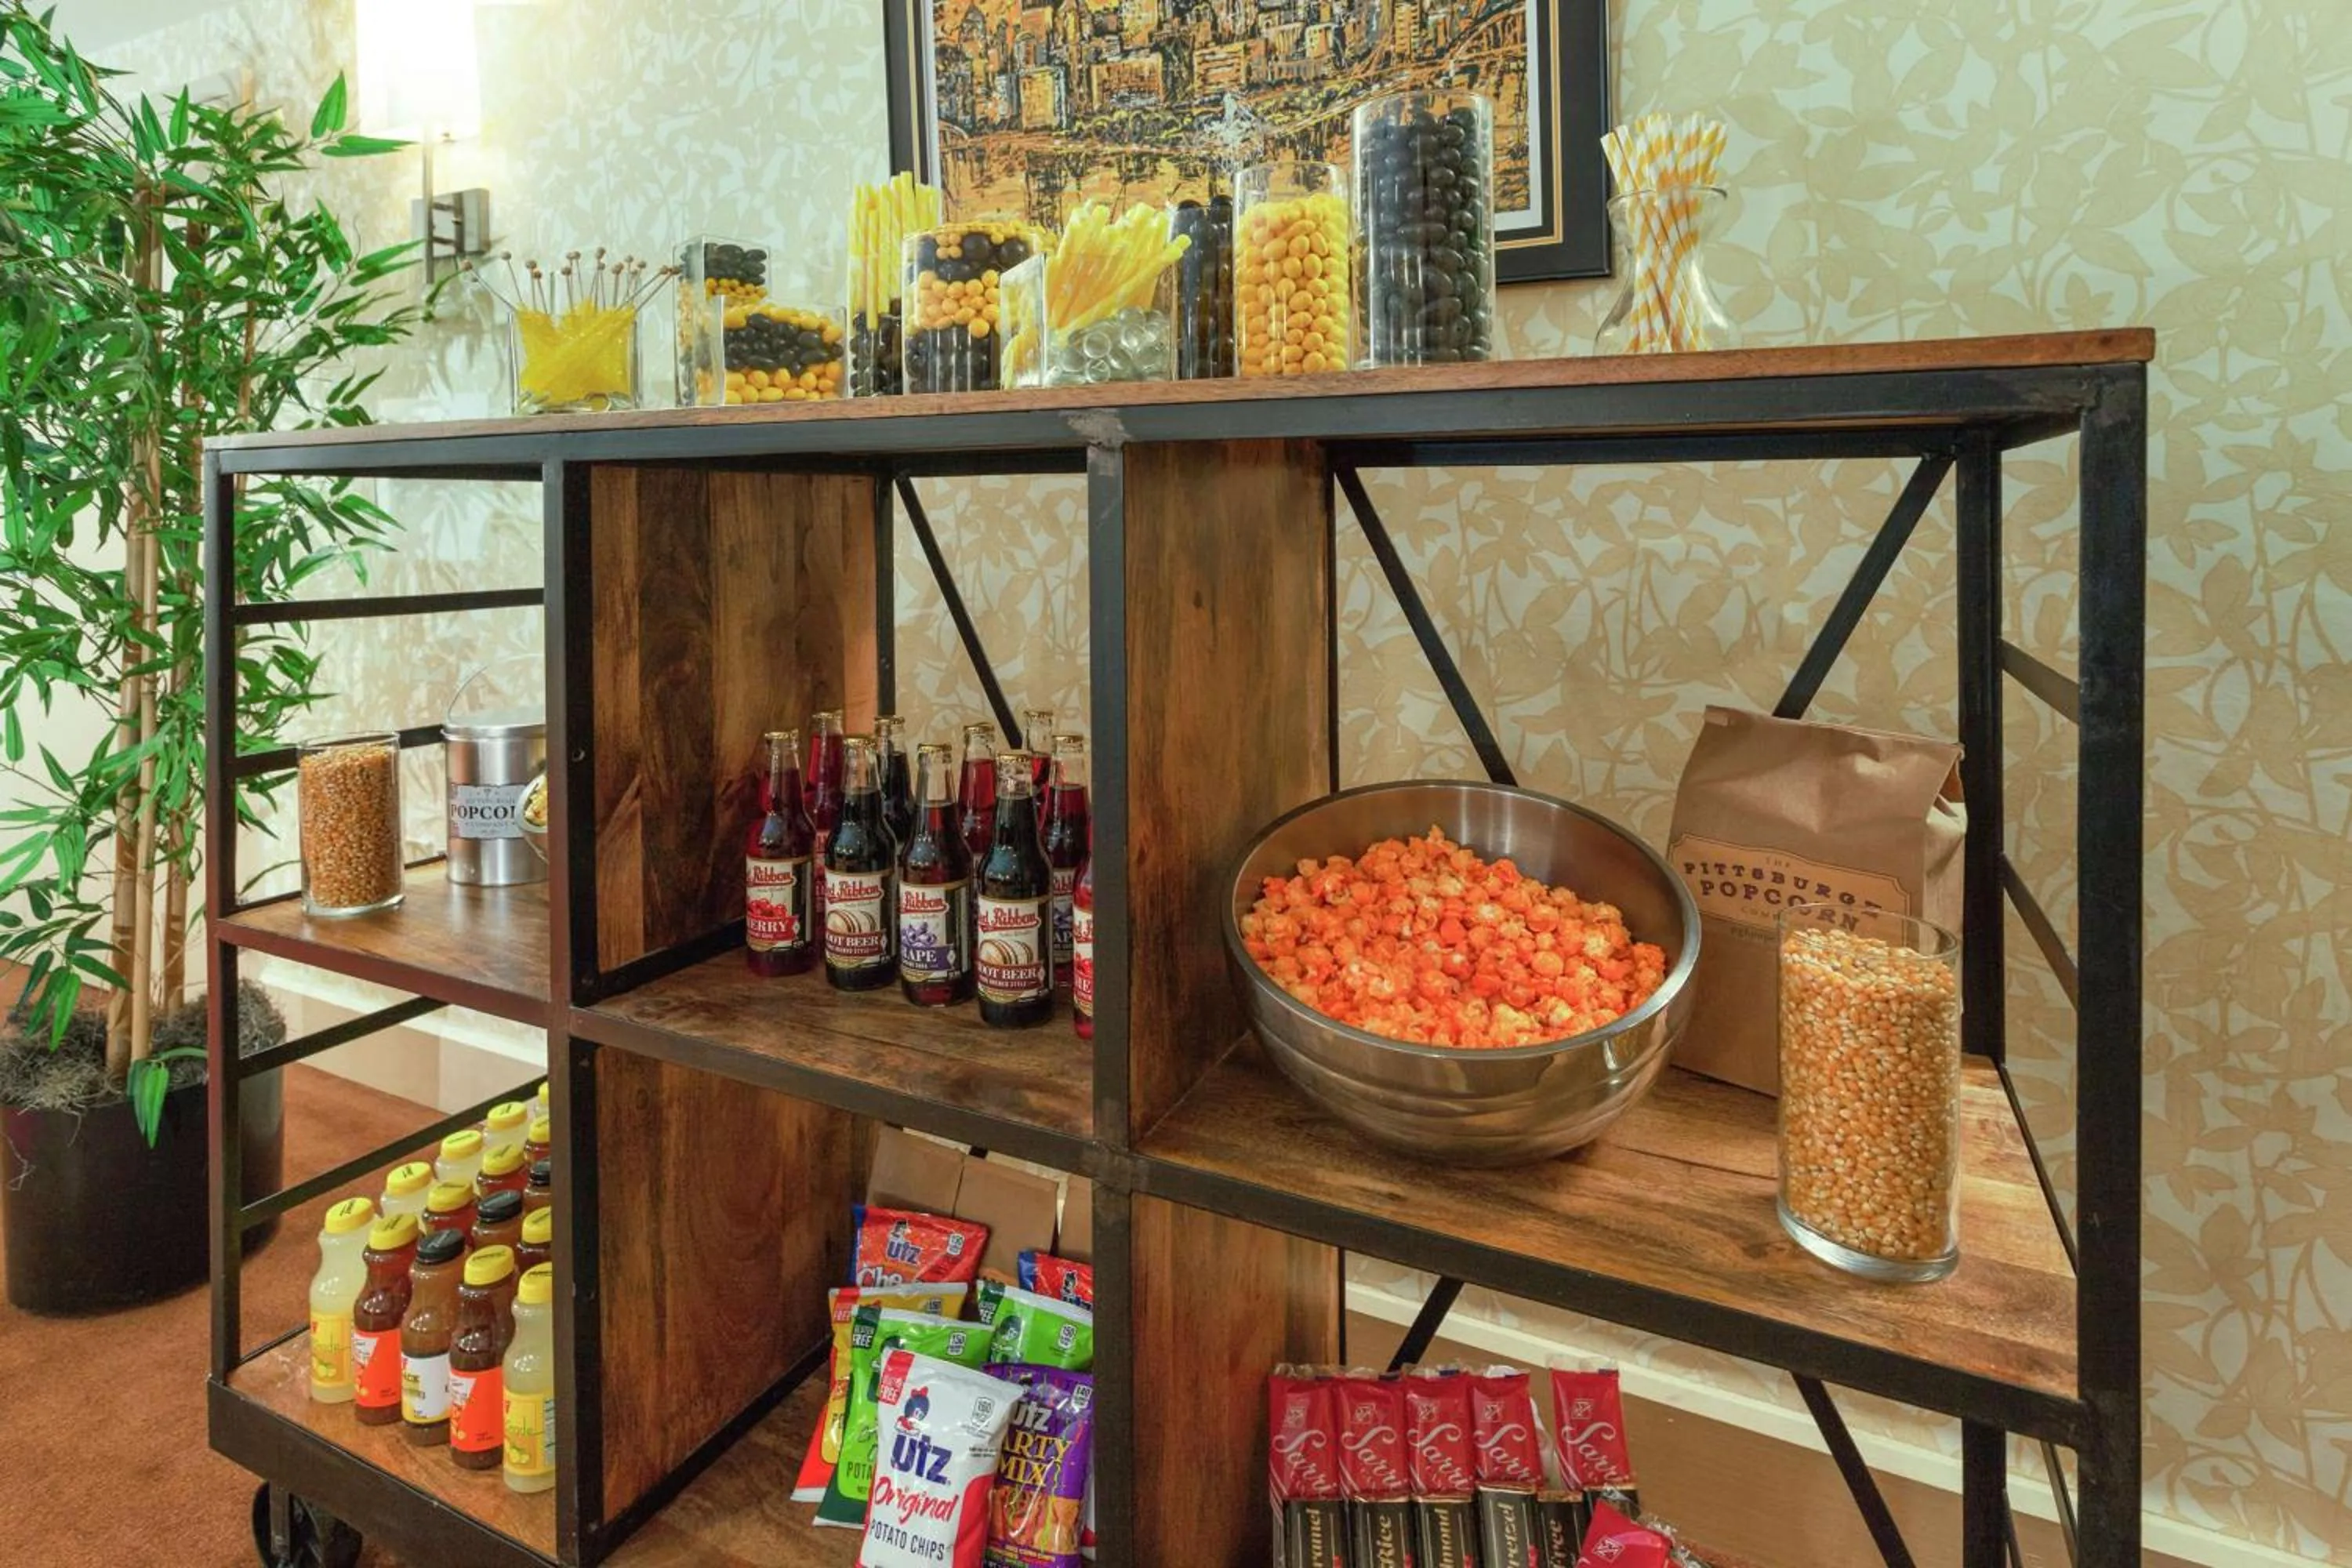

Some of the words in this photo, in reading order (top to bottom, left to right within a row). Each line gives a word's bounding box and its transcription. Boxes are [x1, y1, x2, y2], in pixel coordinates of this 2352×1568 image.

[990, 906, 1036, 925] Ribbon
[1700, 880, 1860, 931] POPCORN
[847, 936, 879, 946] BEER
[1002, 968, 1036, 979] BEER
[997, 1454, 1047, 1487] MIX
[1272, 1429, 1338, 1491] Sarri
[1341, 1425, 1408, 1489] Sarri
[1407, 1423, 1474, 1490] Sarri
[874, 1475, 960, 1525] Original
[910, 1534, 946, 1562] CHIPS
[1306, 1508, 1323, 1568] ramel
[1434, 1508, 1454, 1568] lmond
[1497, 1501, 1519, 1568] retzel
